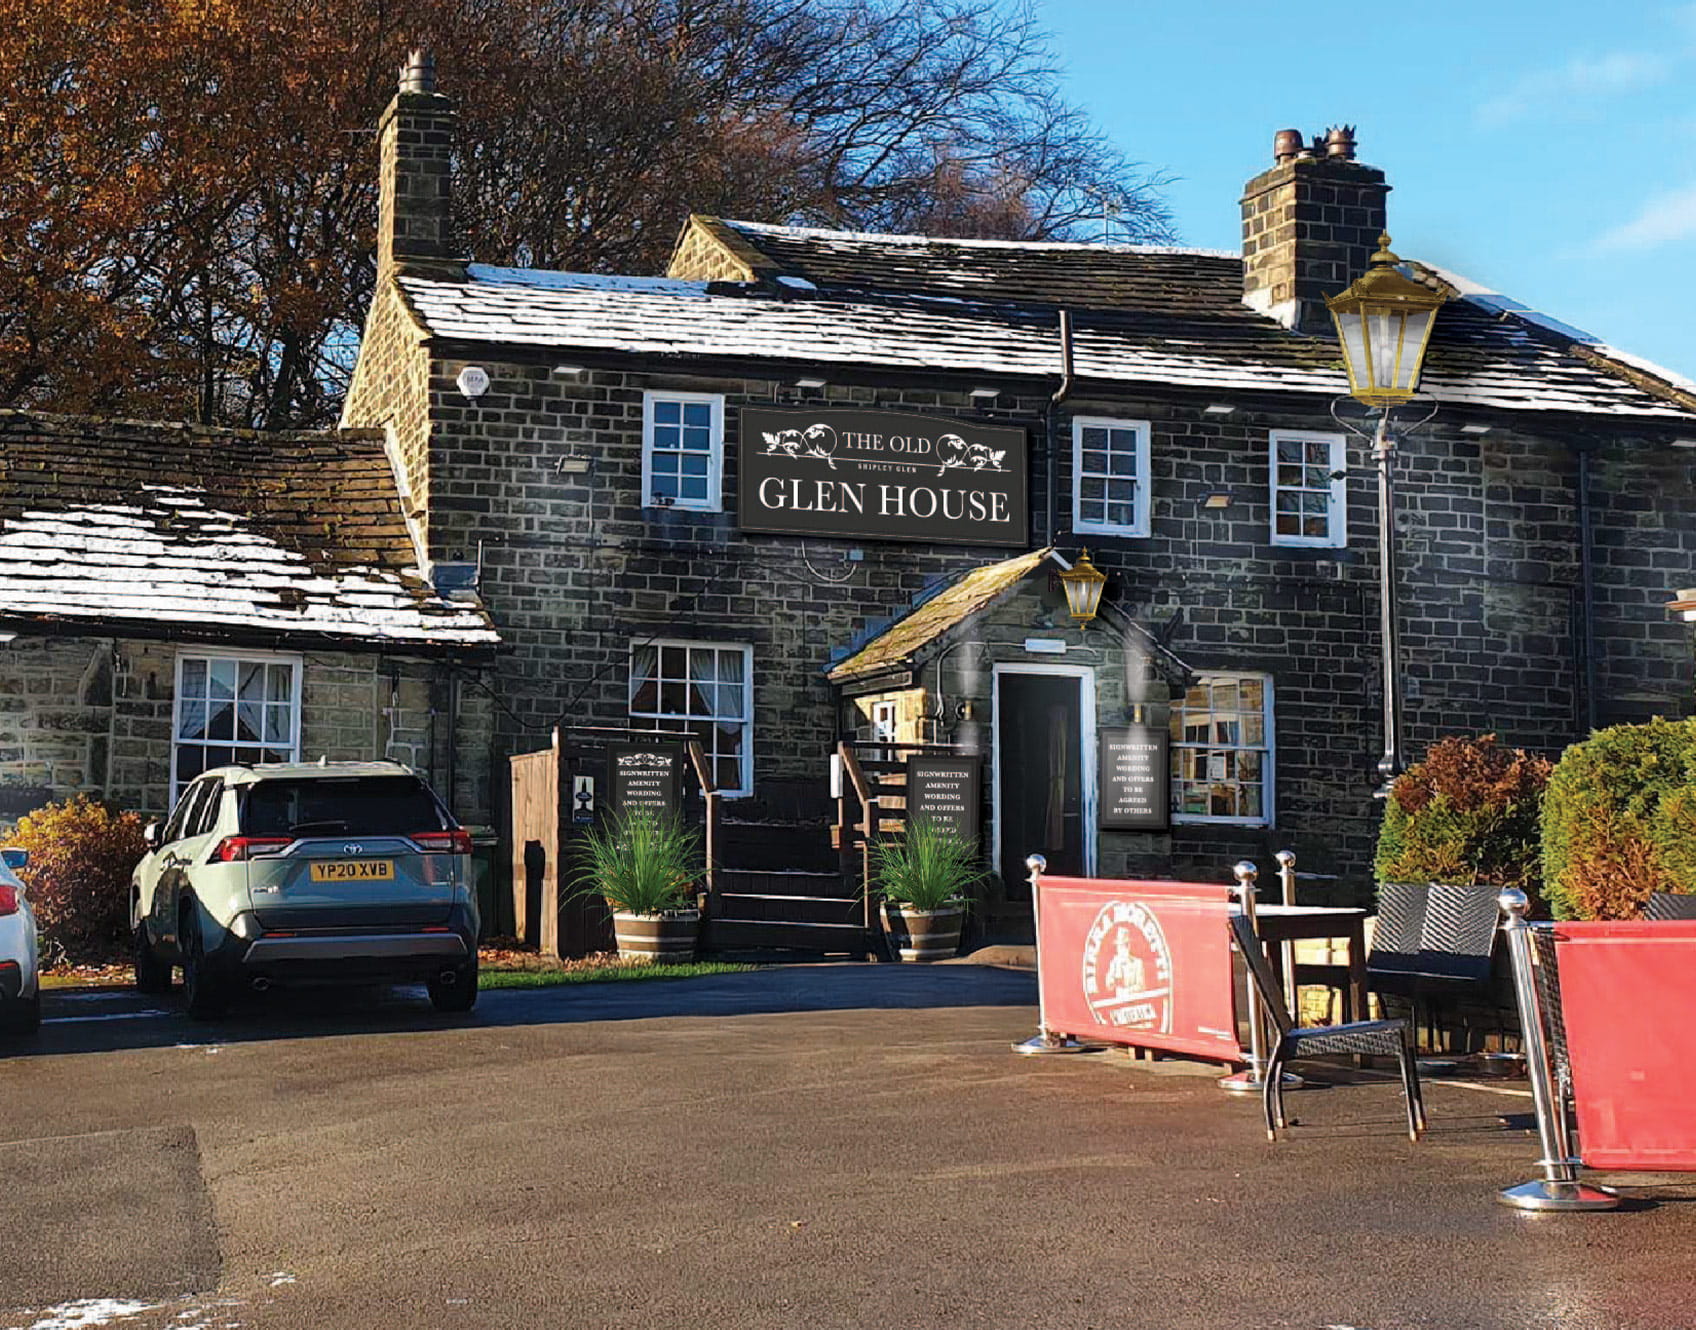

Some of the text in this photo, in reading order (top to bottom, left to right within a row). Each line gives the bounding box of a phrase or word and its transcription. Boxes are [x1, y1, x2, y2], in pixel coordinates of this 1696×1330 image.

[842, 431, 932, 454] THE OLD
[758, 476, 1011, 523] GLEN HOUSE
[1109, 743, 1158, 751] SIGNWRITTEN
[916, 770, 969, 778] SIGNWRITTEN
[1127, 775, 1154, 783] OFFERS
[317, 862, 387, 878] YP20 XVB
